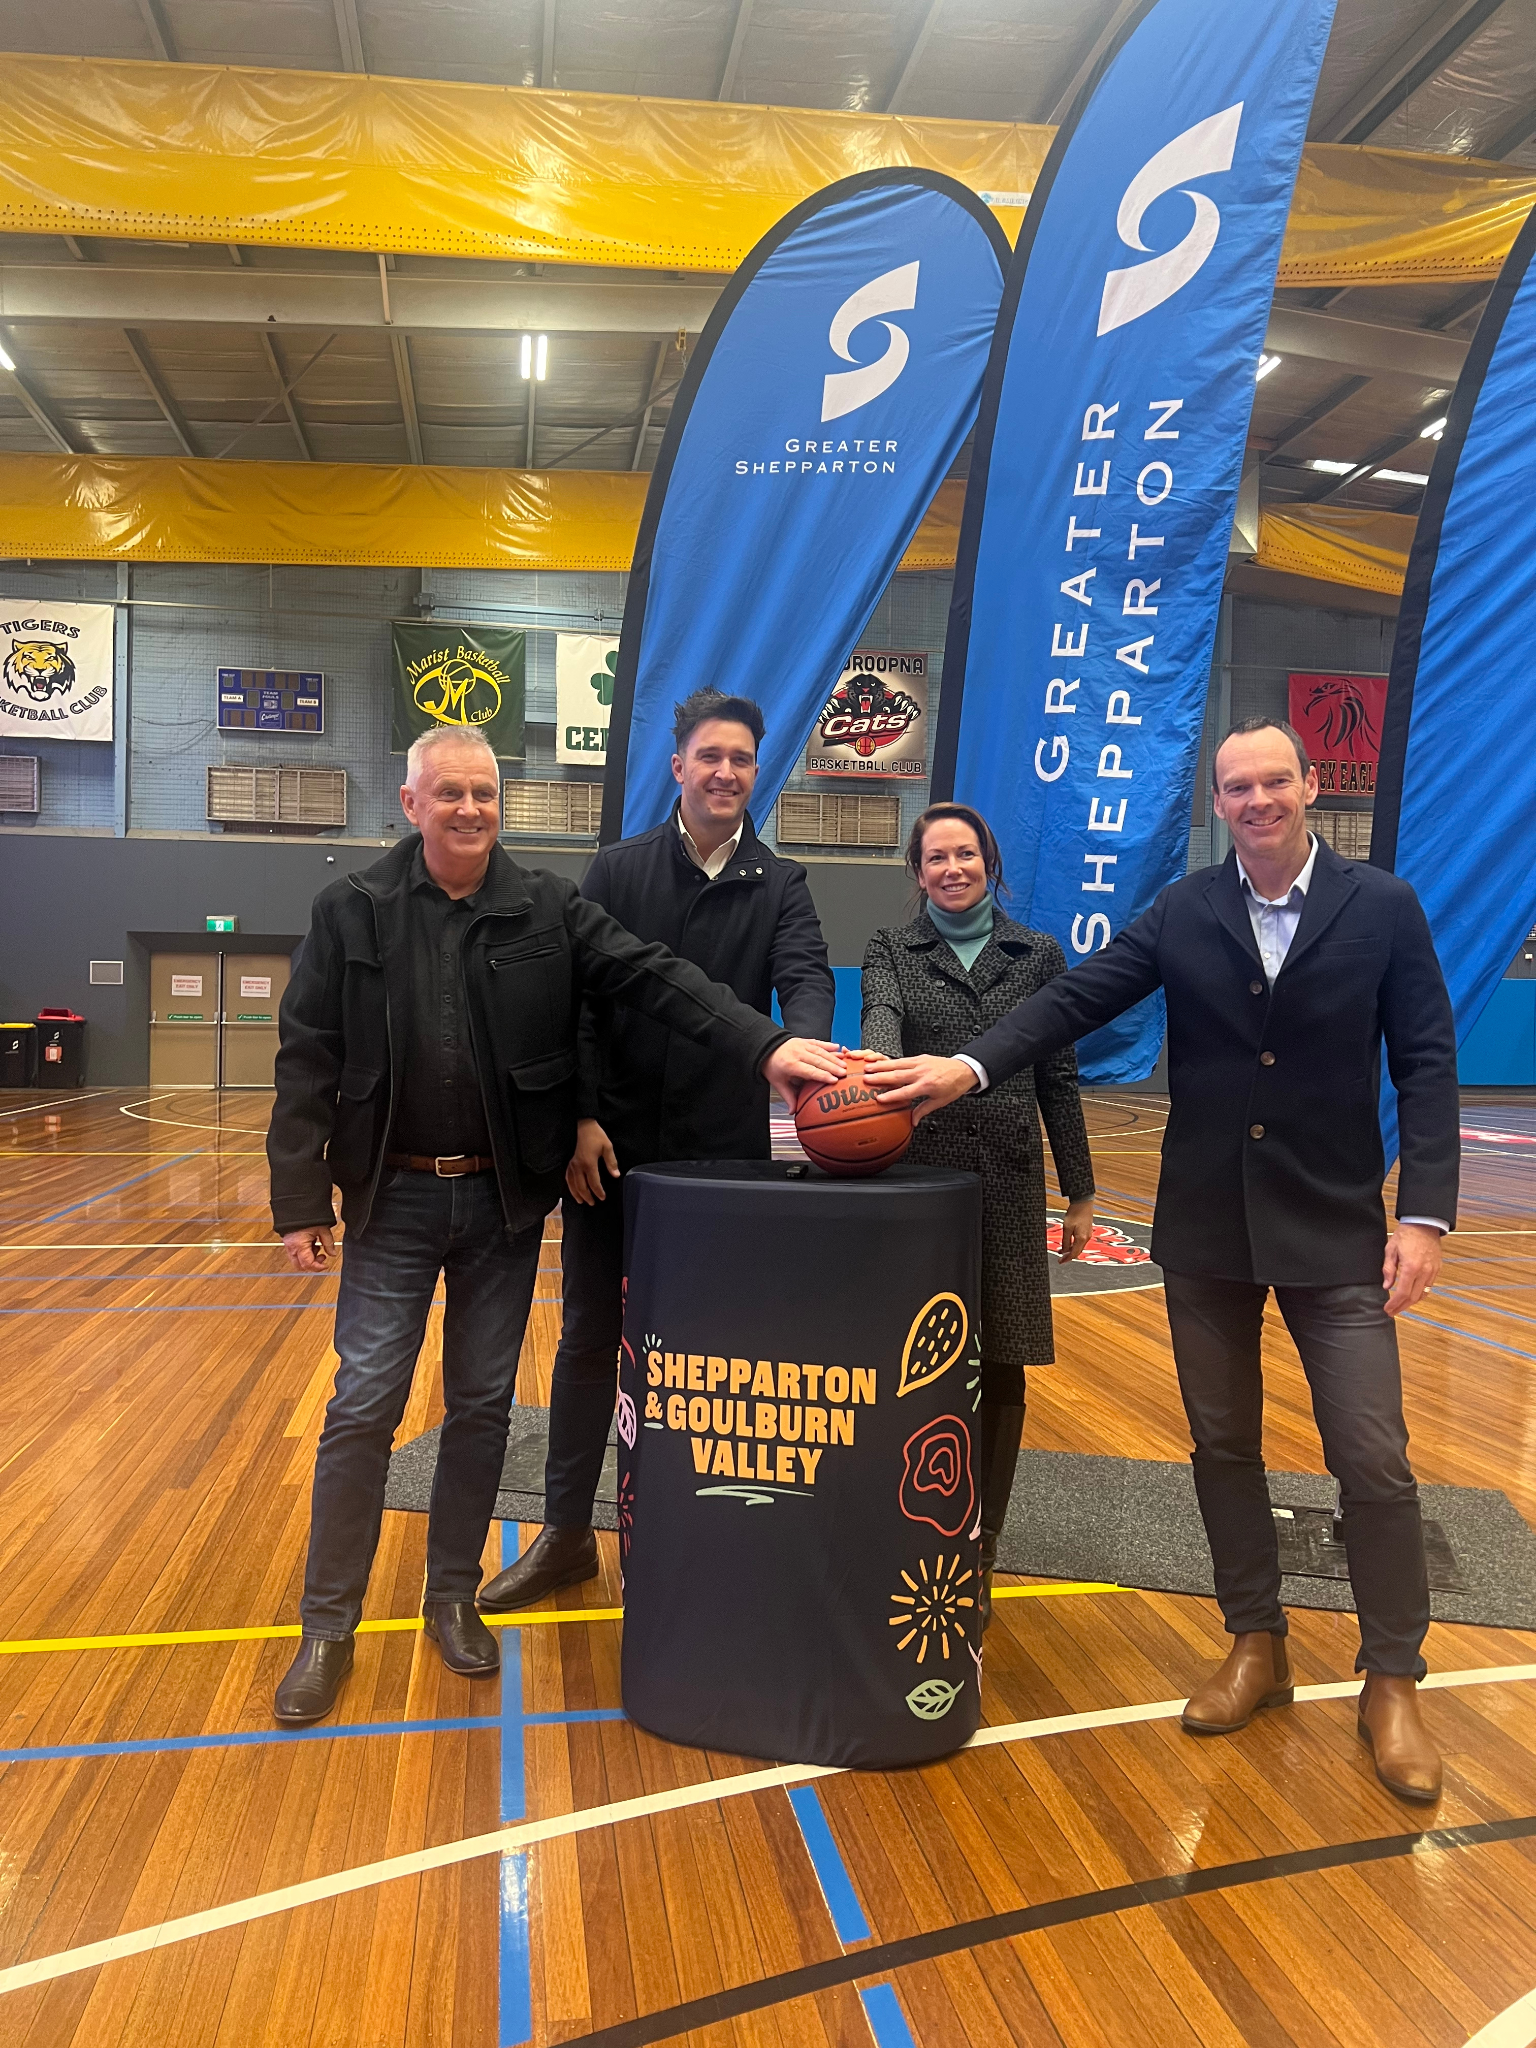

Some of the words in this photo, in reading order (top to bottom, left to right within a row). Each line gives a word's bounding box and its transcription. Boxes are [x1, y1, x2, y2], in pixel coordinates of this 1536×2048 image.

[785, 438, 898, 453] GREATER
[735, 460, 896, 475] SHEPPARTON
[1034, 400, 1120, 782] GREATER
[0, 619, 81, 639] TIGERS
[405, 647, 450, 685] Marist
[456, 645, 511, 684] Basketball
[1070, 398, 1184, 954] SHEPPARTON
[0, 696, 69, 721] KETBALL
[69, 685, 108, 715] CLUB
[470, 706, 493, 722] Club
[823, 713, 908, 737] Cats
[811, 758, 888, 772] BASKETBALL
[891, 761, 922, 773] CLUB
[1339, 760, 1379, 792] EAGL
[646, 1350, 877, 1405] SHEPPARTON
[644, 1390, 664, 1420] &
[666, 1394, 855, 1446] GOULBURN
[690, 1437, 823, 1485] VALLEY
